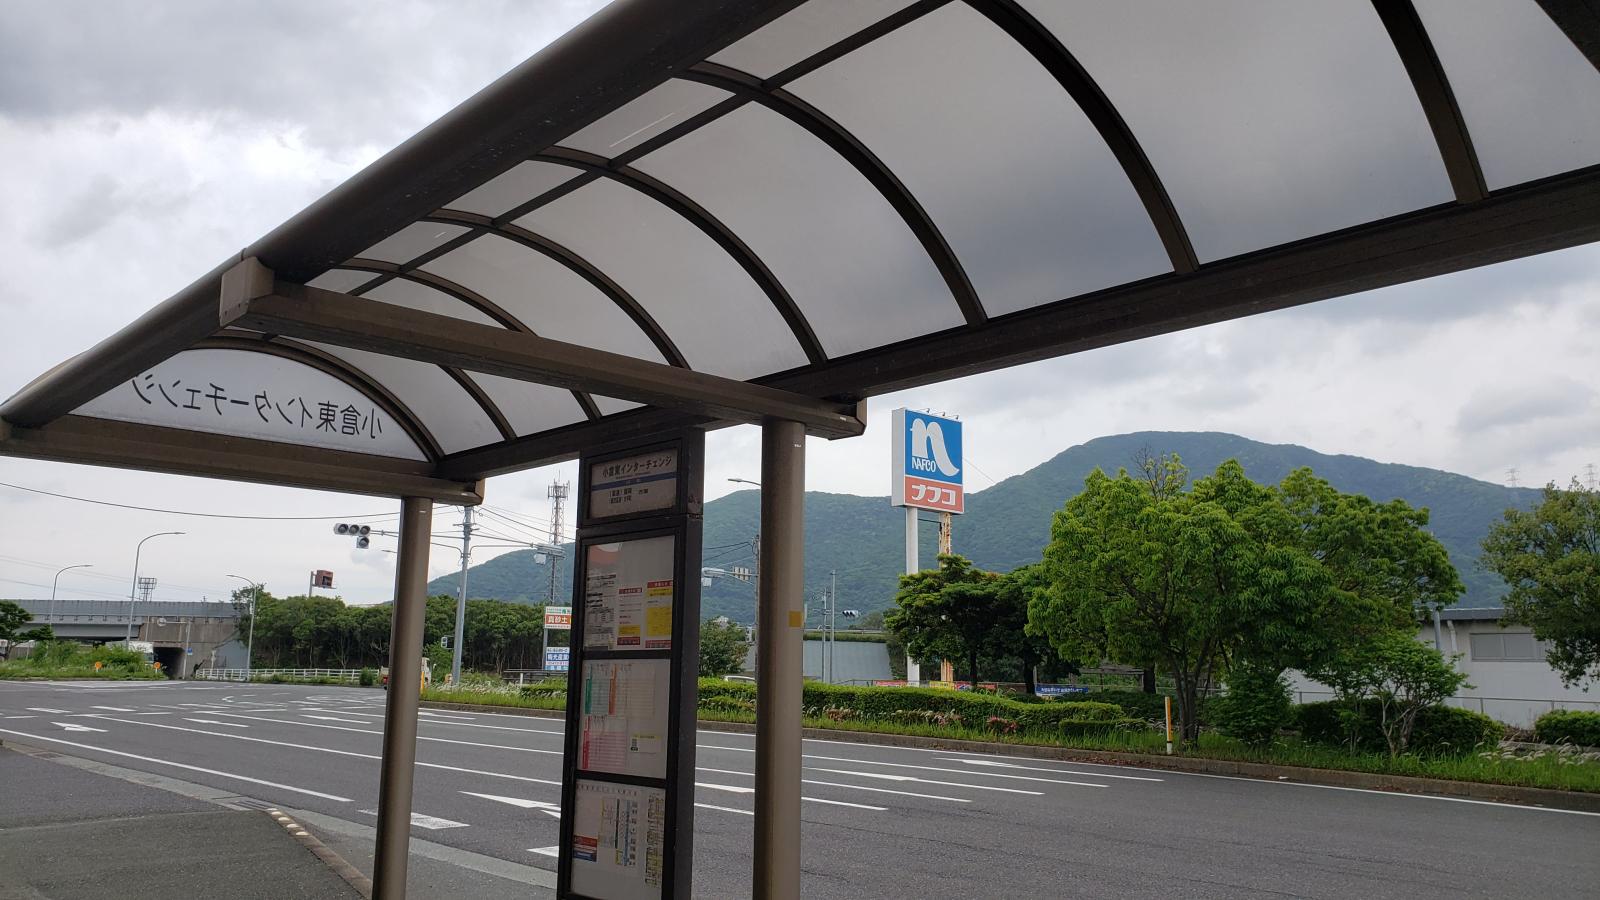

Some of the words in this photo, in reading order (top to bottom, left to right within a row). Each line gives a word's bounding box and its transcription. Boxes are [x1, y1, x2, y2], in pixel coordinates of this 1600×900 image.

[912, 457, 936, 473] NAFCO
[911, 484, 956, 506] ナフコ
